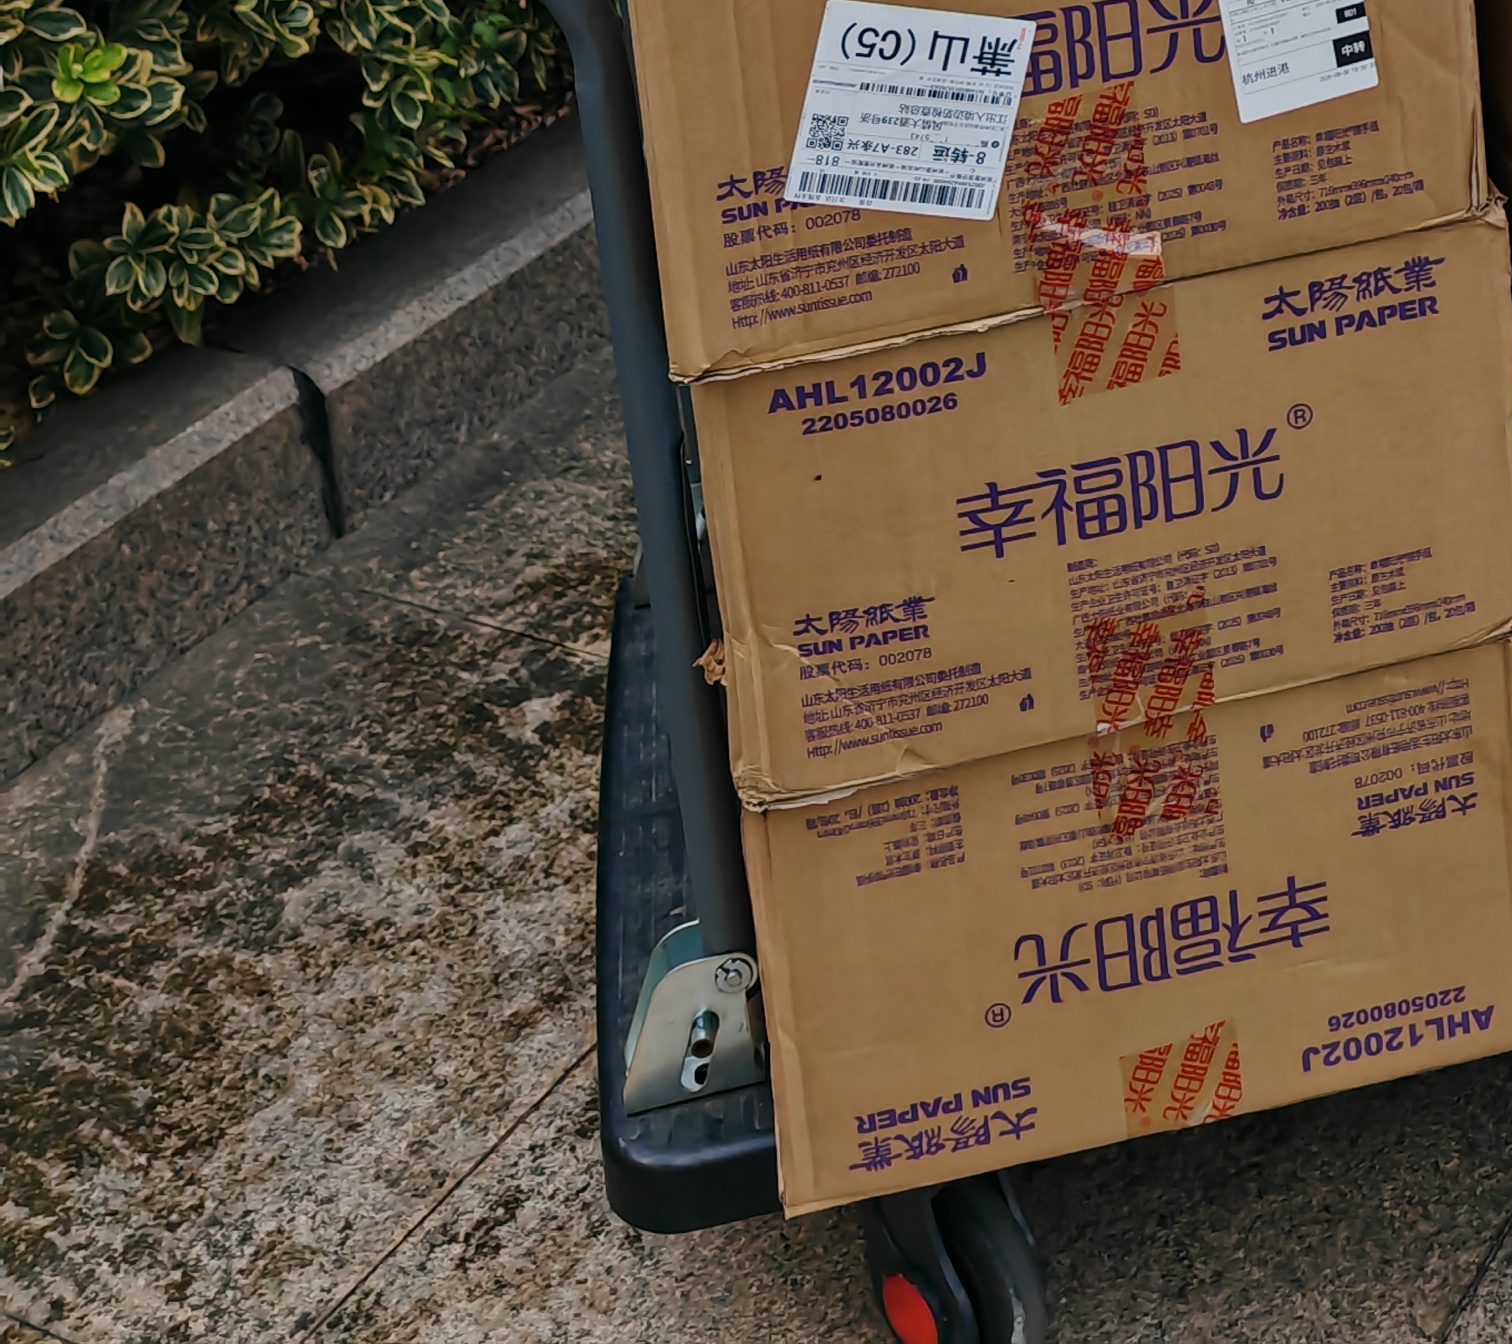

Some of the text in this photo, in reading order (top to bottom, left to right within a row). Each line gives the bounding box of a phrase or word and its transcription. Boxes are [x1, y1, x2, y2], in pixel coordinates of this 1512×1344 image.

[1340, 38, 1366, 58] 中转
[1240, 60, 1290, 86] 杭州进港
[805, 152, 840, 167] 818-
[845, 138, 919, 157] 283-A7永兴
[930, 144, 987, 165] 8-转运
[718, 203, 767, 219] SUN
[1262, 258, 1444, 320] 太陽紙業
[1268, 297, 1438, 351] SUN PAPER
[769, 353, 986, 413] AHL12002J
[802, 394, 958, 436] 2205080026
[957, 429, 1284, 557] 幸福阳光
[794, 597, 934, 647] 太陽紙業
[797, 626, 929, 658] SUN PAPER
[1351, 784, 1477, 837] 太陽紙業
[1356, 774, 1475, 809] SUN PAPER
[1014, 878, 1330, 1005] 幸福阳光
[1327, 987, 1465, 1032] 2205080026
[1302, 1007, 1493, 1073] AHL12002J
[855, 1078, 1031, 1133] SUN PAPER
[849, 1108, 1037, 1171] 太陽紙業
